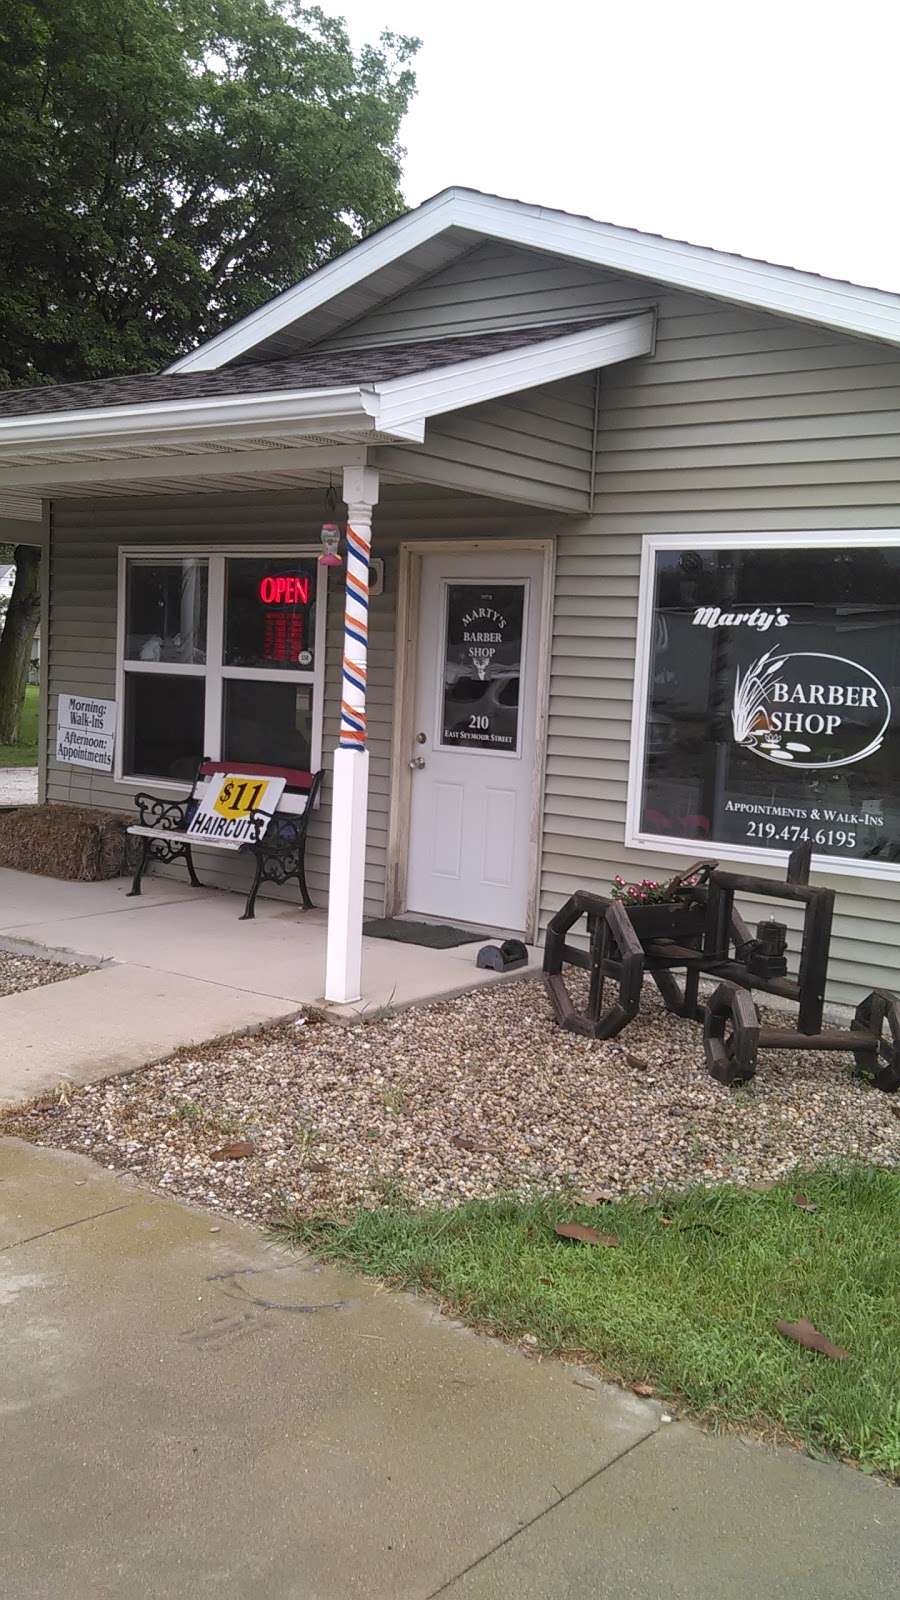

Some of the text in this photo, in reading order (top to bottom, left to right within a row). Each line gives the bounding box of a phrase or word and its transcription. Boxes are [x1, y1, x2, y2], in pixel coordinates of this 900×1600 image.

[260, 576, 309, 605] OPEN
[462, 607, 507, 629] MARTY'S
[692, 607, 791, 632] Marty's
[463, 631, 502, 643] BARBER
[468, 647, 496, 657] SHOP
[772, 682, 879, 708] BARBER
[69, 698, 107, 717] Morning:
[70, 711, 104, 729] Walk-Ins
[468, 714, 489, 730] 210
[770, 711, 841, 735] SHOP
[63, 731, 107, 749] Afternoon:
[444, 729, 513, 744] EAST SEYMOUR STREET
[57, 743, 112, 765] Appointments
[219, 780, 263, 812] $11
[725, 800, 884, 827] APPOINTMENTS & WALK-INS
[746, 821, 857, 849] 219.474.6195
